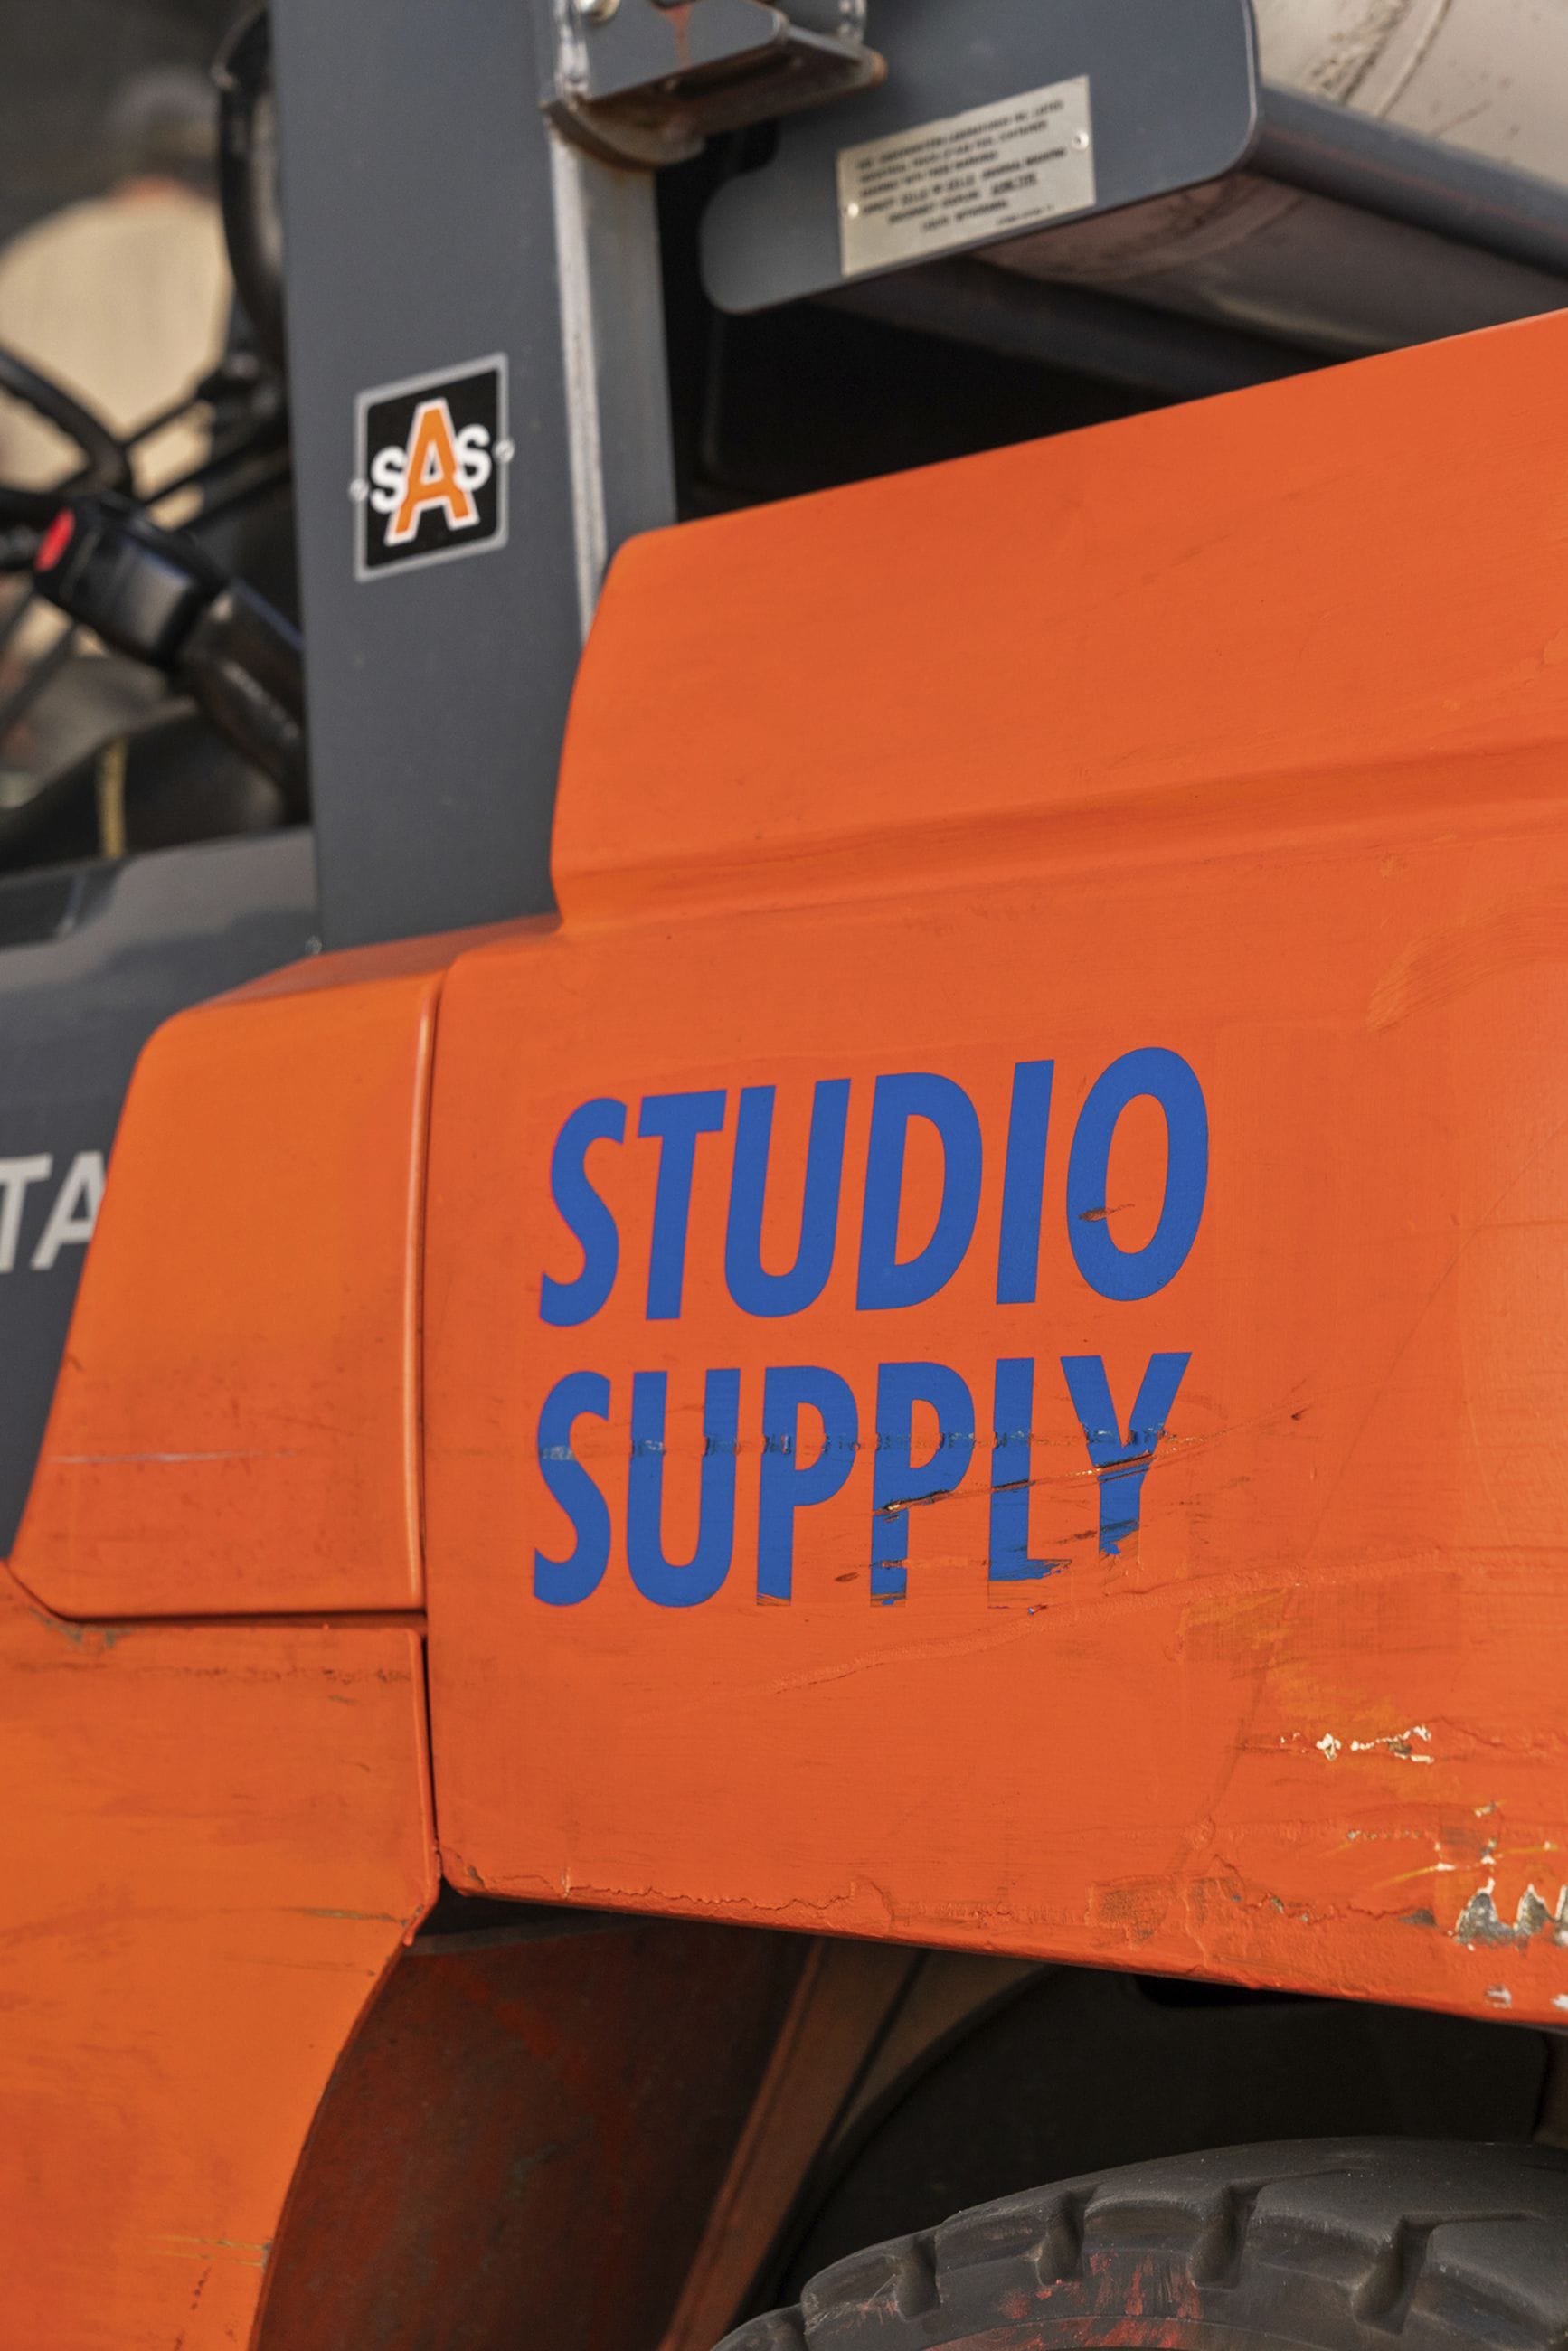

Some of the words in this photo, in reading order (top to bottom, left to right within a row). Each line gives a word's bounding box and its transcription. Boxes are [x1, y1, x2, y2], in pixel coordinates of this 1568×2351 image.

[369, 396, 493, 547] SAS
[539, 1046, 1209, 1327] STUDIO
[534, 1352, 1193, 1608] SUPPLY
